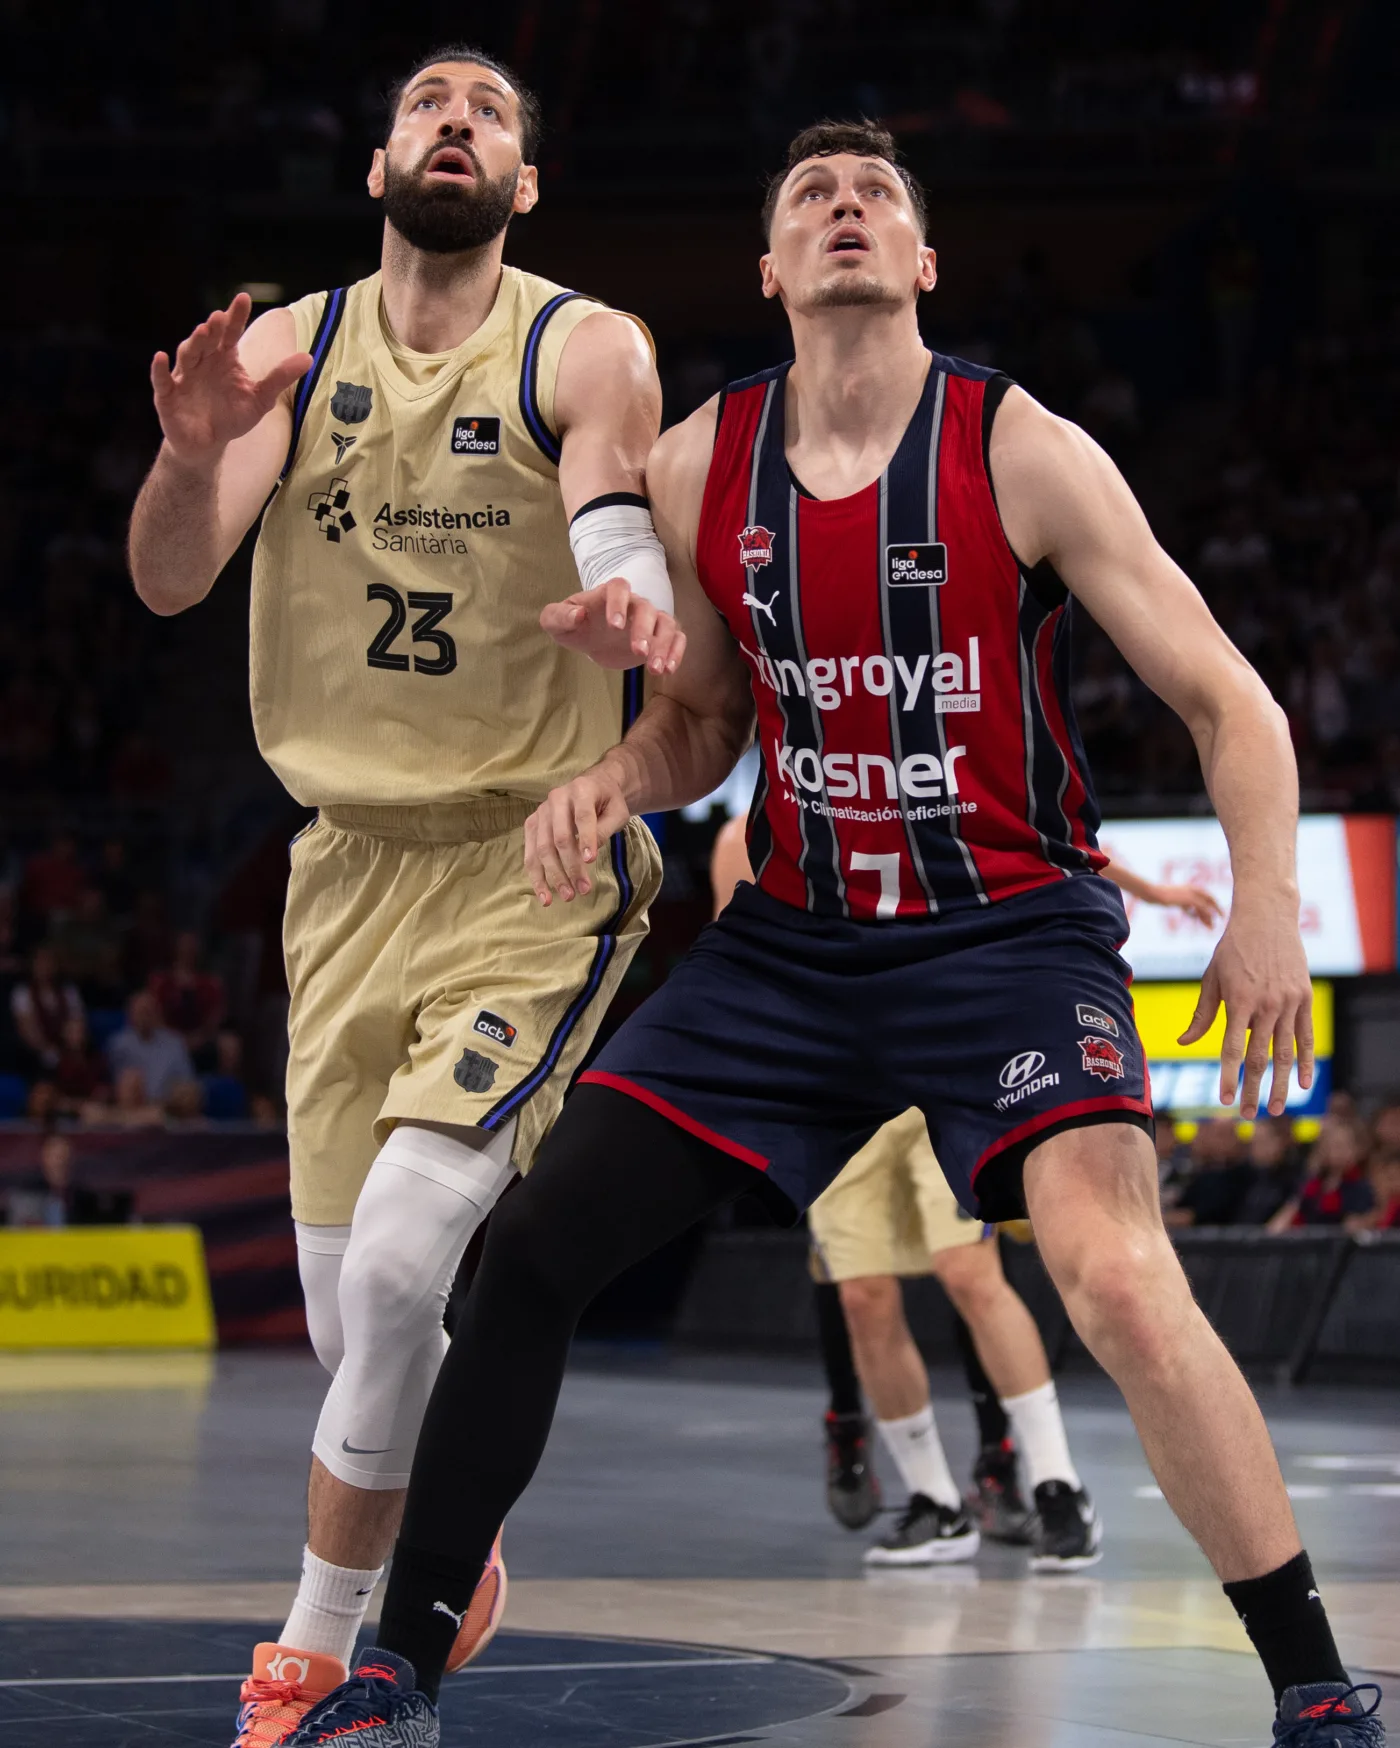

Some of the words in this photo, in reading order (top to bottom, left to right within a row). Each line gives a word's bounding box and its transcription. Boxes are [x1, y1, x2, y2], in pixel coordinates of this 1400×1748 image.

[454, 439, 497, 450] endesa
[455, 426, 475, 440] liga
[373, 502, 510, 529] Assistència
[372, 527, 468, 555] Sanitària
[892, 557, 915, 571] liga
[892, 568, 943, 580] endesa
[366, 582, 458, 676] 23
[774, 737, 967, 800] kosner
[811, 800, 902, 823] Climatización
[906, 801, 978, 821] eficiente
[849, 851, 901, 920] 7
[477, 1021, 506, 1041] acb
[1083, 1012, 1110, 1030] acb
[993, 1072, 1060, 1113] HYUNDAI
[0, 1263, 190, 1311] URIDAD
